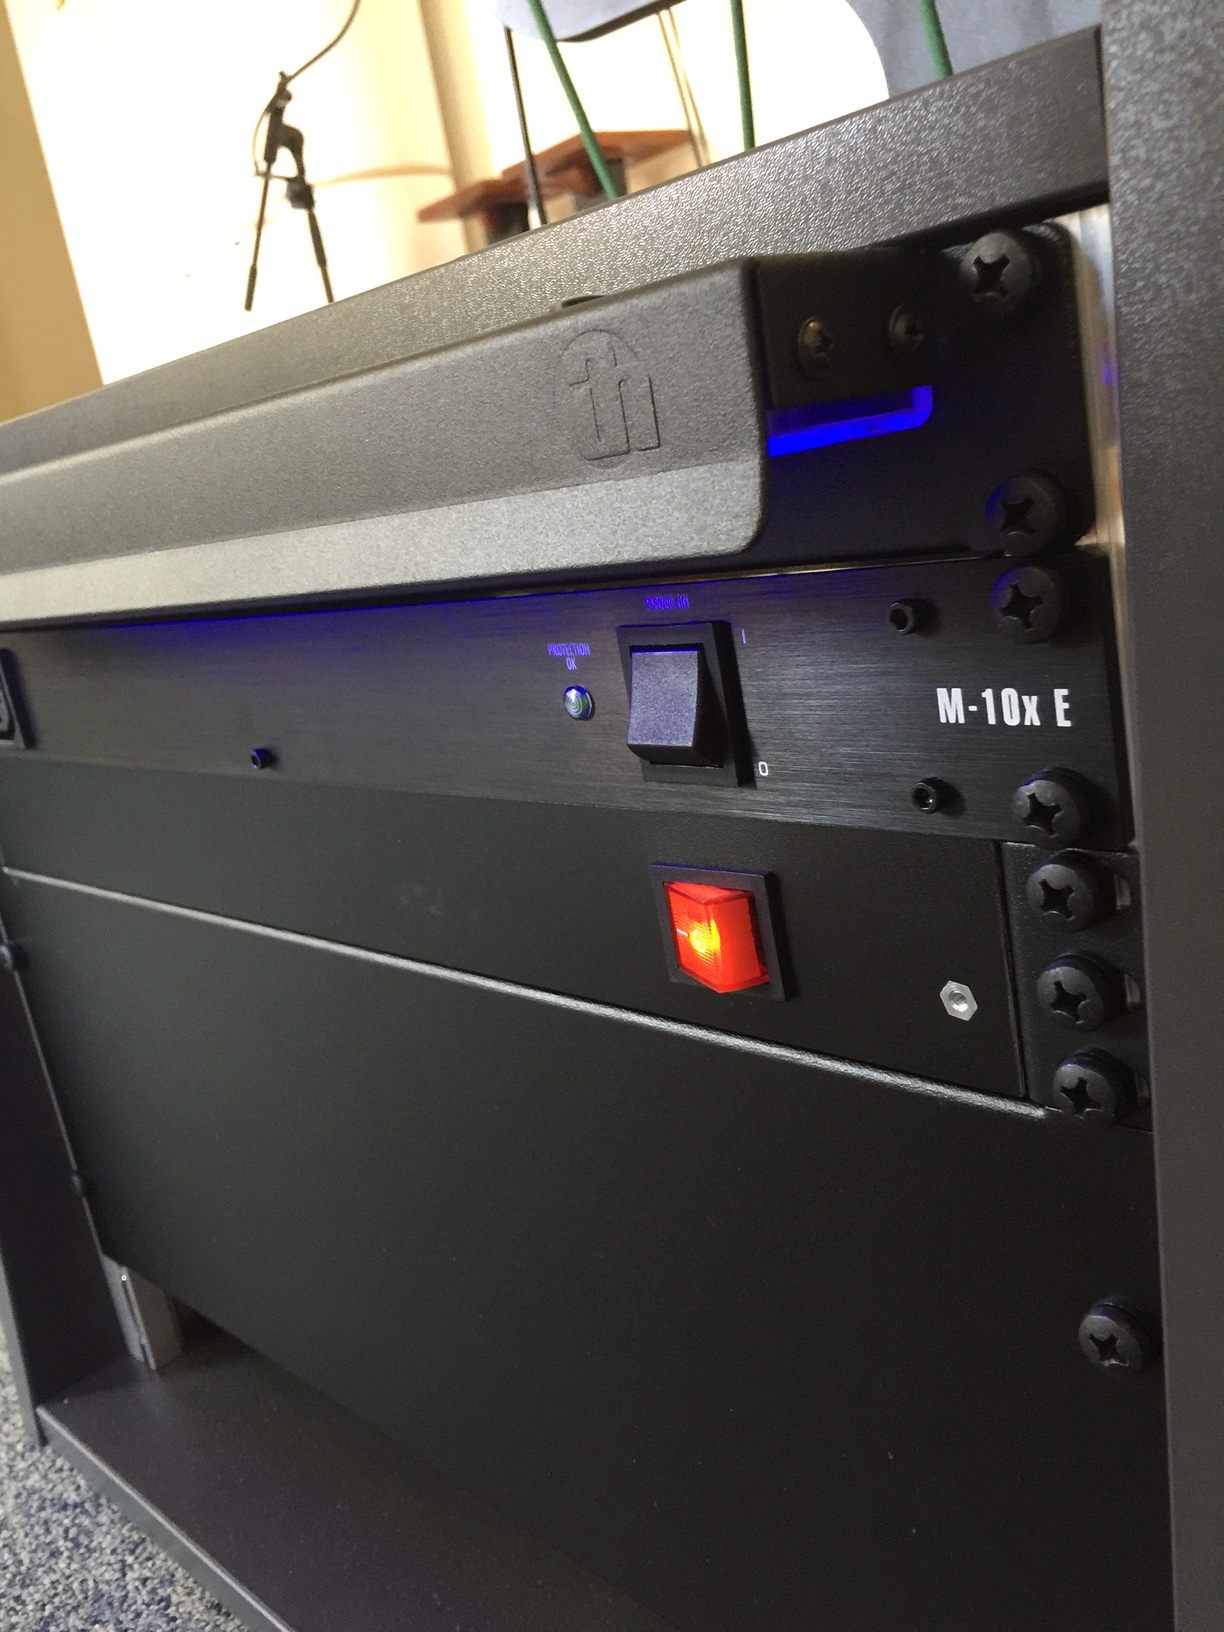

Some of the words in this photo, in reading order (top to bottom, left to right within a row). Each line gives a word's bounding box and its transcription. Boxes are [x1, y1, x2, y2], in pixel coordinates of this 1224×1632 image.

[547, 642, 591, 657] PROTECTION
[565, 657, 577, 670] OK
[936, 687, 1041, 726] M-10x
[1053, 688, 1072, 727] E
